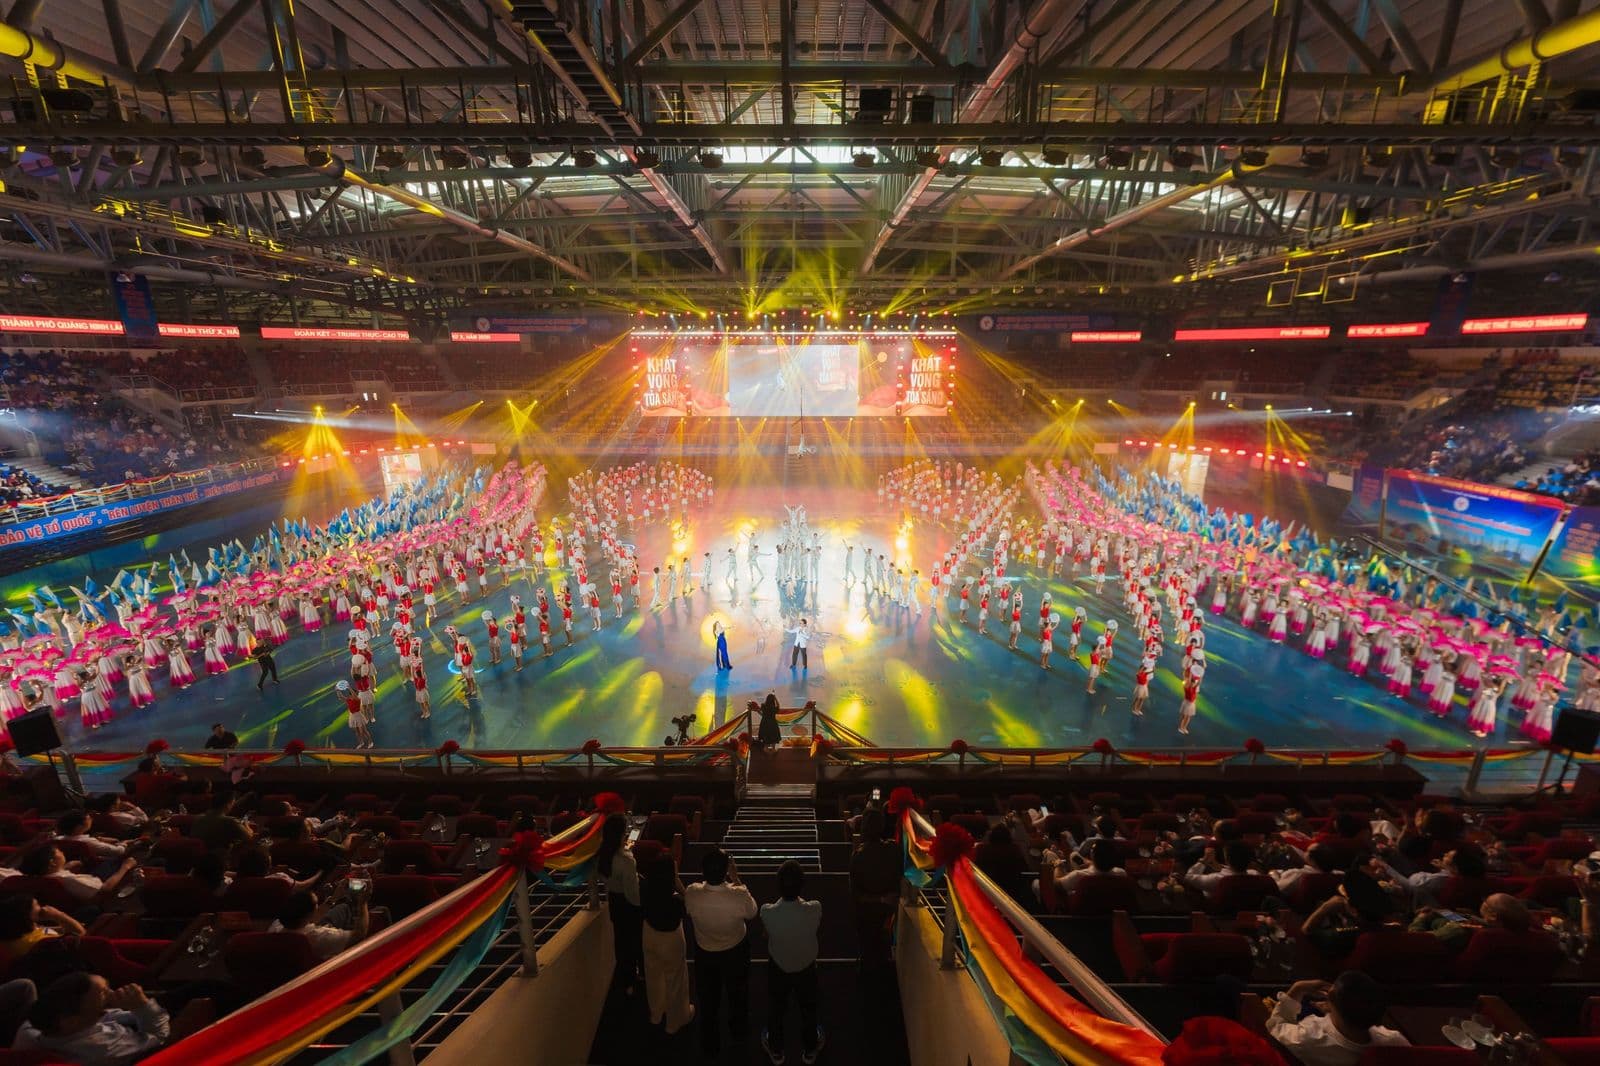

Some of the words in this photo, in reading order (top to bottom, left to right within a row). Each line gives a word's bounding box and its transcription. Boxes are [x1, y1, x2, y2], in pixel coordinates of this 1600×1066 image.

[2, 318, 34, 328] THÀNH
[647, 356, 677, 373] KHÁT
[911, 355, 942, 372] KHÁT
[647, 374, 679, 391] VỌNG
[910, 372, 942, 391] VỌNG
[0, 528, 25, 545] BẢO
[26, 524, 43, 540] VỆ
[44, 518, 60, 534] TỔ
